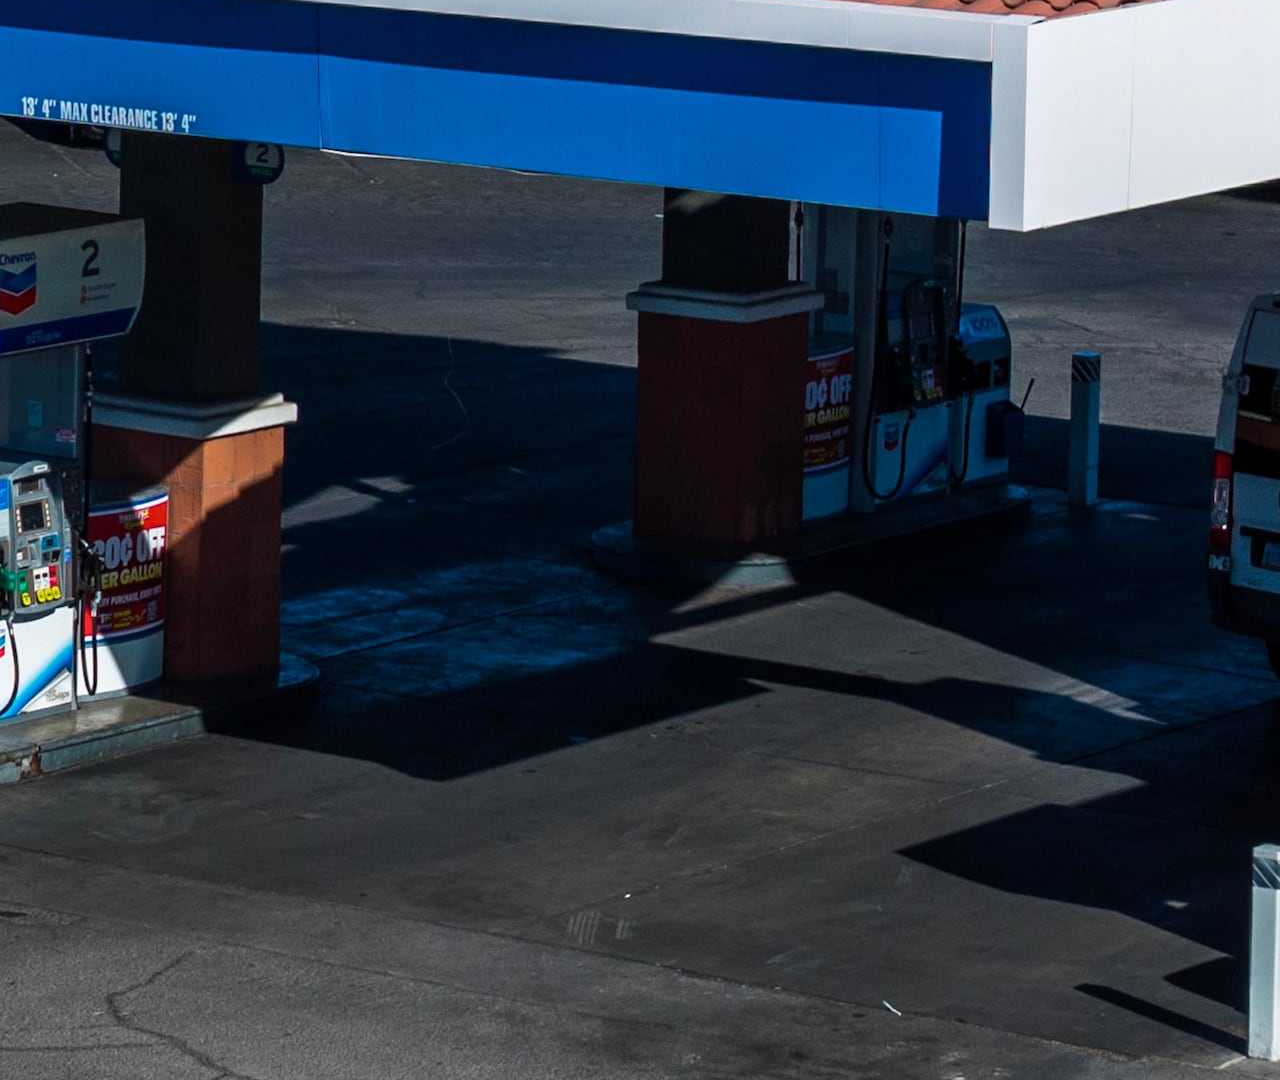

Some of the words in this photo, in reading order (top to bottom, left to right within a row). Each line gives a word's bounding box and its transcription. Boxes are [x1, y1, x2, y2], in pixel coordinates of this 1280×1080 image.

[60, 100, 88, 123] MAX
[91, 103, 158, 130] CLEARANCE
[80, 239, 100, 278] 2
[136, 526, 166, 563] OFF
[120, 561, 162, 586] GALLON
